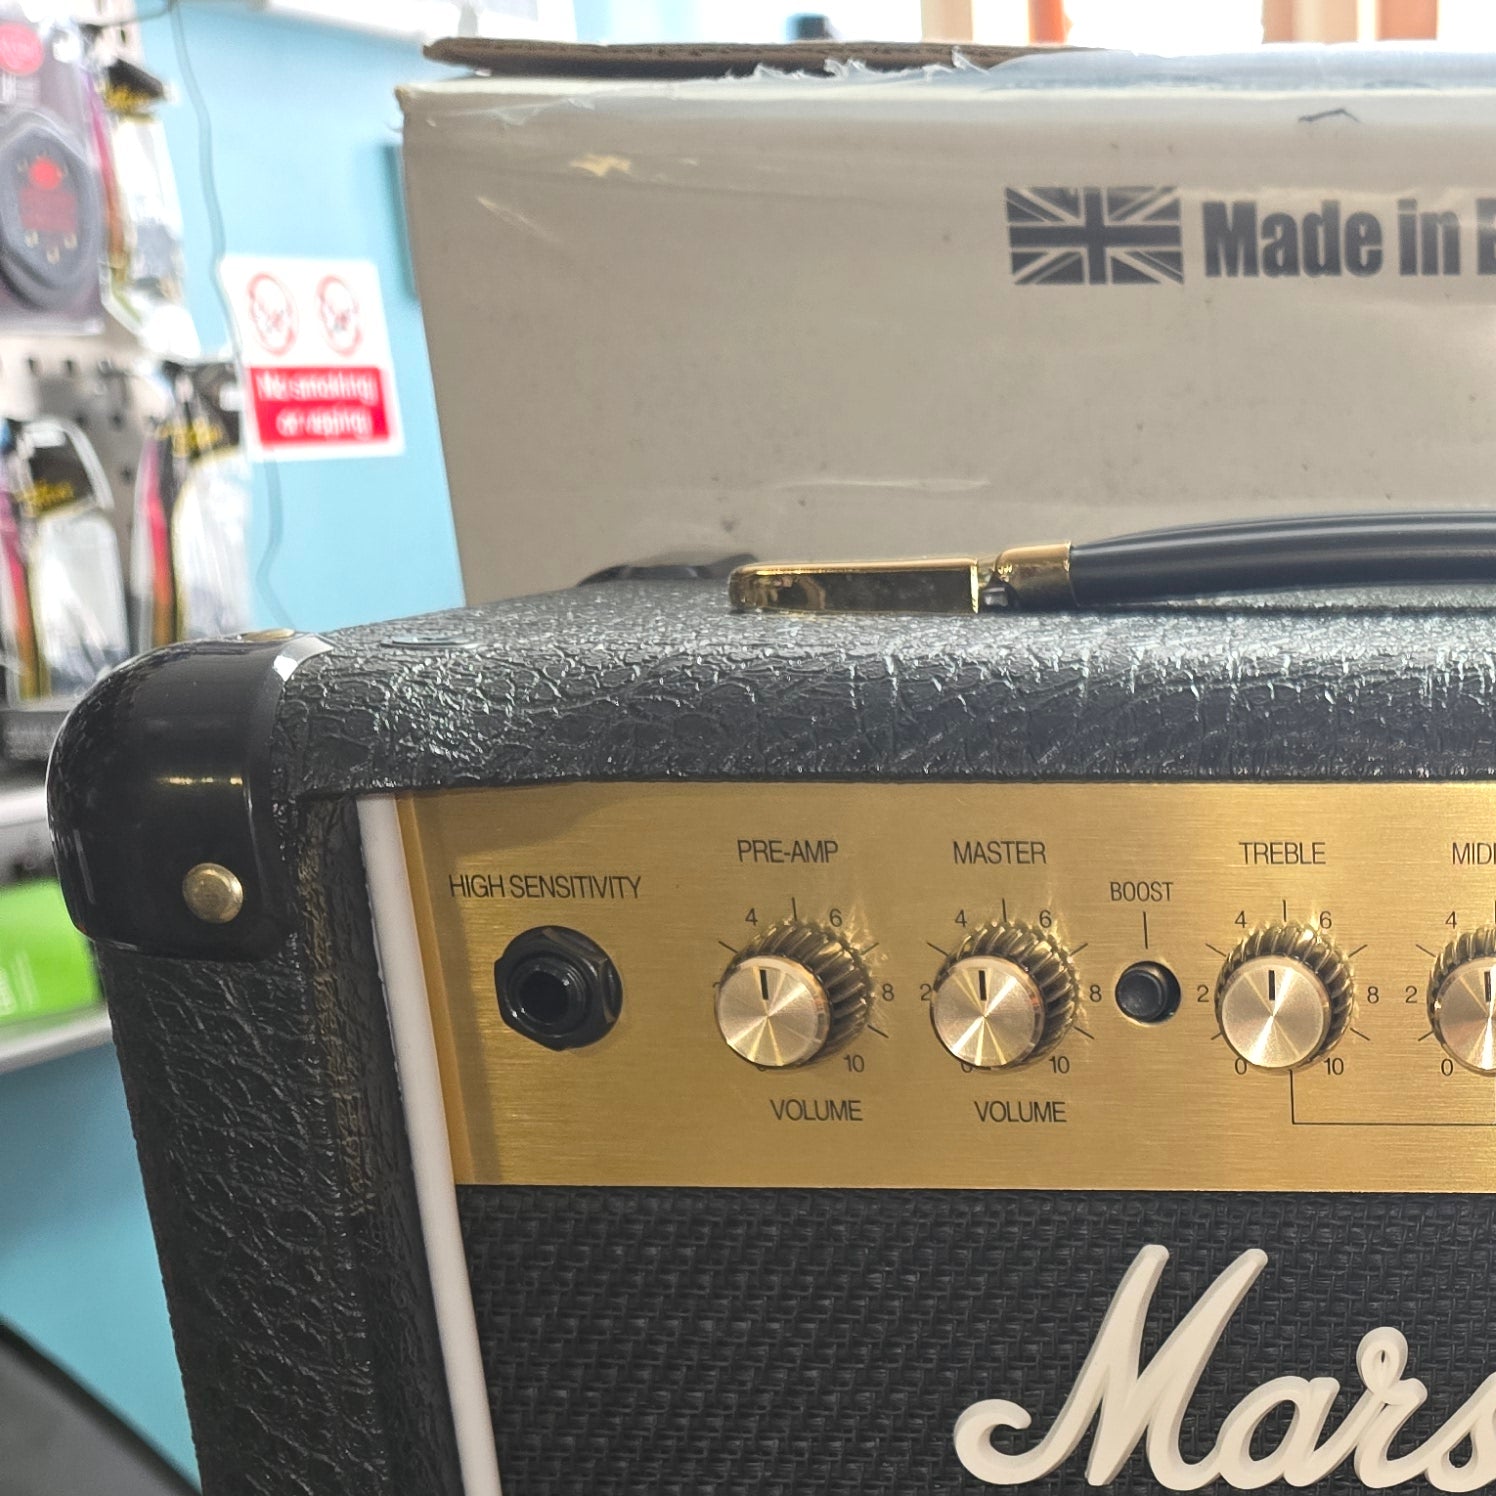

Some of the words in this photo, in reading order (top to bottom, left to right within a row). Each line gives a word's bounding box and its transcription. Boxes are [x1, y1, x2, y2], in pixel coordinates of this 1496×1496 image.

[1203, 200, 1384, 278] Made
[1397, 198, 1461, 276] in
[737, 839, 839, 863] PRE-AMP
[953, 841, 1047, 864] MASTER
[1239, 842, 1326, 865] TREBLE
[449, 875, 504, 898] HIGH
[511, 875, 642, 899] SENSITIVITY
[1110, 882, 1173, 902] BOOST
[745, 907, 757, 926] 4
[829, 908, 843, 927] 6
[954, 909, 967, 927] 4
[1039, 910, 1052, 929] 6
[1235, 911, 1247, 929] 4
[1320, 911, 1333, 929] 6
[1445, 911, 1457, 929] 4
[882, 983, 895, 1001] 8
[920, 983, 932, 1001] 2
[1090, 984, 1102, 1003] 8
[1197, 985, 1209, 1003] 2
[1367, 986, 1379, 1004] 8
[1405, 986, 1417, 1004] 2
[844, 1054, 866, 1073] 10
[1049, 1055, 1070, 1074] 10
[1235, 1057, 1248, 1075] 0
[1326, 1056, 1345, 1075] 10
[1441, 1058, 1453, 1077] 0
[770, 1099, 864, 1122] VOLUME
[974, 1100, 1067, 1124] VOLUME
